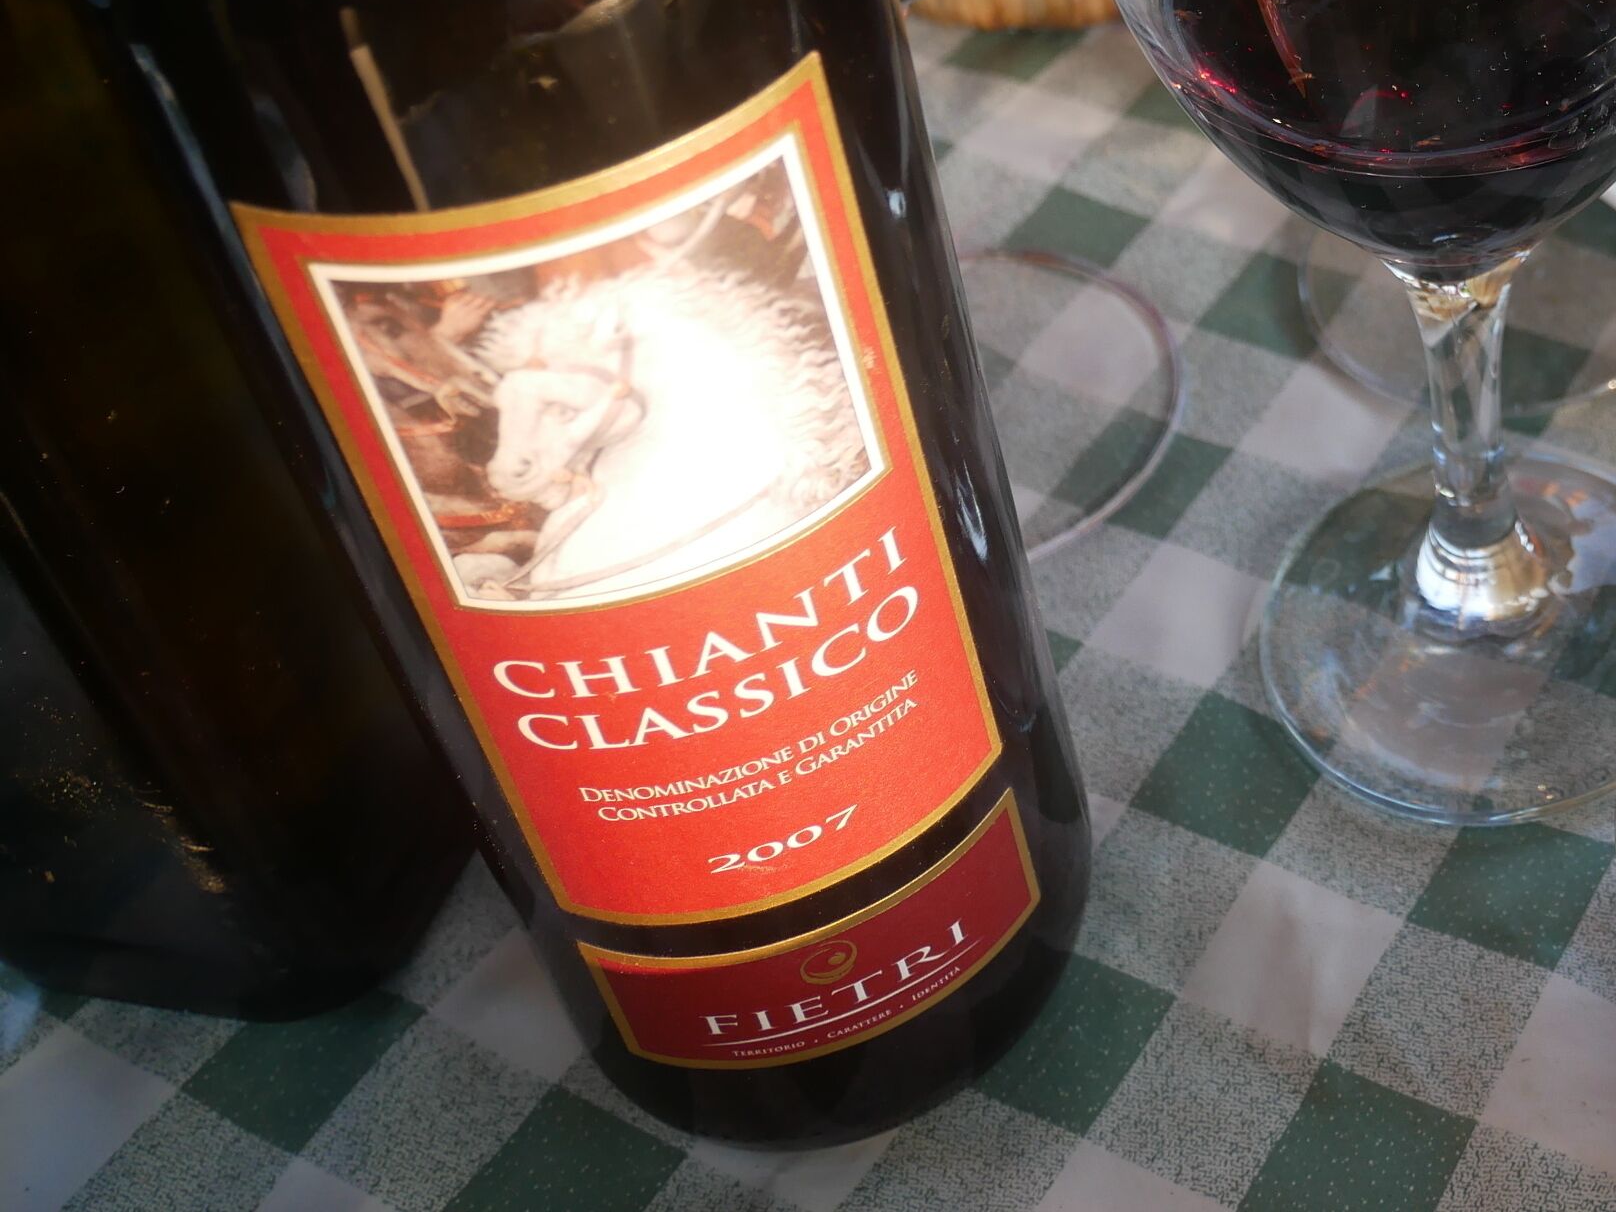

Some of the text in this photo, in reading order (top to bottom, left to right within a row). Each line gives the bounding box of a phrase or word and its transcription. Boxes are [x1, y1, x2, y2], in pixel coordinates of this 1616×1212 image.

[493, 527, 907, 699] CHIANTI
[517, 586, 919, 750] CLASSICO
[579, 669, 919, 803] DENOMINAZIONE DI ORIGINE
[598, 697, 919, 822] CONTROLLATA E GARANTITA
[707, 804, 858, 874] 2007
[702, 917, 969, 1036] FIETRI
[732, 1040, 806, 1058] TERRITORIO
[826, 1008, 892, 1039] CARATTERE
